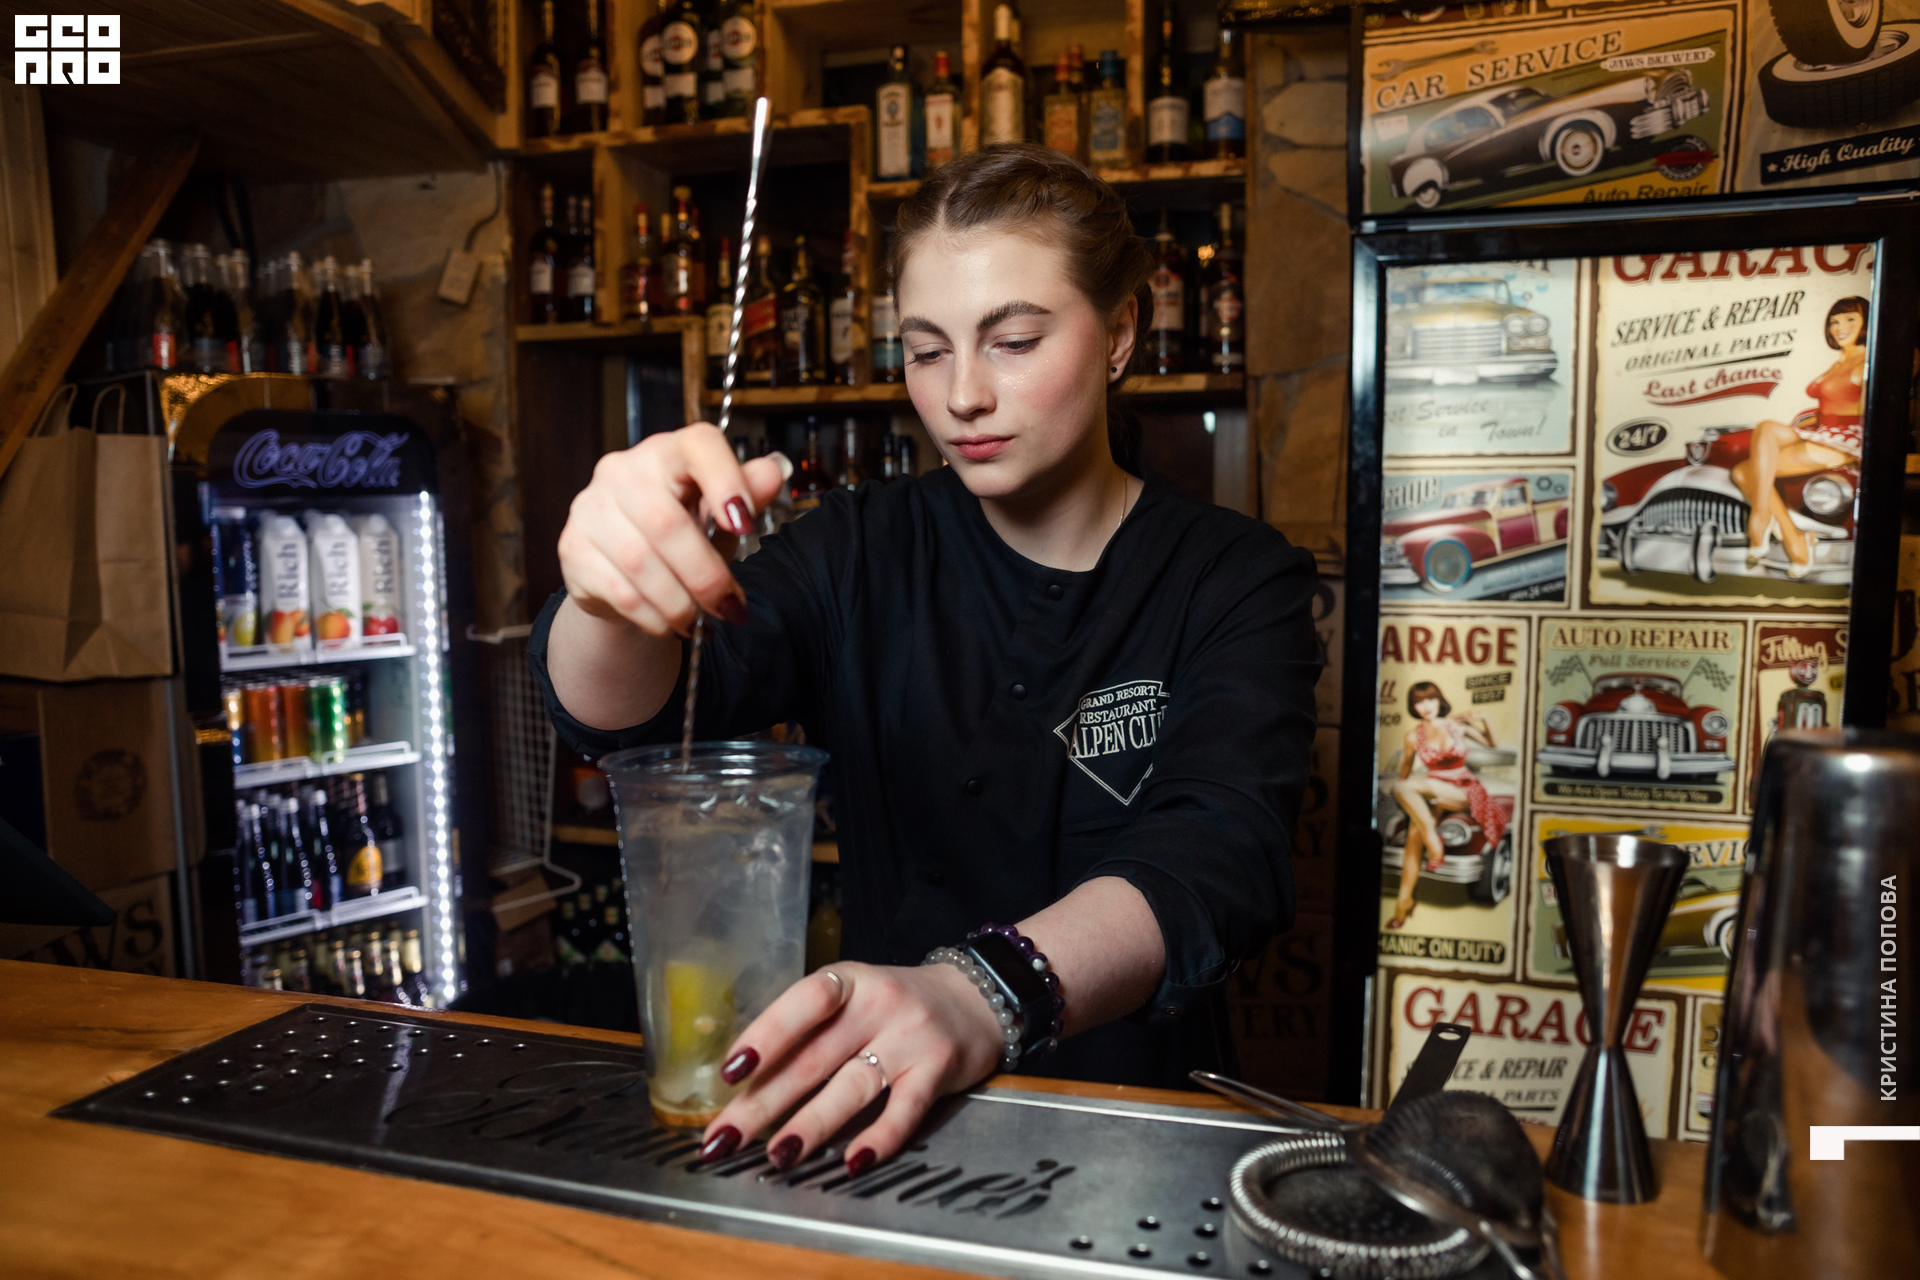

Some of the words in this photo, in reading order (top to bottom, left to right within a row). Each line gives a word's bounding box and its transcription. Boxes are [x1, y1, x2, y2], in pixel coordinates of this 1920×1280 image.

[1377, 74, 1446, 109] CAR
[1468, 31, 1622, 87] SERVICE
[1647, 50, 1708, 65] BREWERY
[1780, 148, 1832, 172] High
[1837, 136, 1915, 162] Quality
[1613, 243, 1875, 284] GARAG
[1611, 307, 1700, 347] SERVICE
[1702, 304, 1720, 331] &
[1723, 290, 1805, 327] REPAIR
[1625, 342, 1722, 372] ORIGINAL
[1730, 328, 1797, 354] PARTS
[1643, 380, 1697, 398] Last
[1704, 366, 1782, 391] chance
[1416, 400, 1491, 421] Service
[1618, 424, 1660, 449] 24/7
[276, 543, 298, 597] Rich
[327, 542, 348, 595] Rich
[372, 540, 393, 593] Rich
[1381, 625, 1517, 666] ARAGE
[1552, 626, 1622, 647] AUTO
[1630, 628, 1730, 649] REPAIR
[1760, 634, 1829, 671] Filling
[1588, 653, 1621, 668] Full
[1626, 654, 1690, 669] Service
[1079, 698, 1157, 725] RESTAURANT
[1080, 693, 1114, 710] GRAND
[1116, 685, 1157, 701] RESORT
[1068, 719, 1127, 759] ALPEN
[1429, 937, 1455, 959] ON
[1457, 940, 1504, 962] DUTY
[1479, 1058, 1497, 1081] &
[1499, 1056, 1569, 1080] REPAIR
[1503, 1088, 1562, 1104] PARTS
